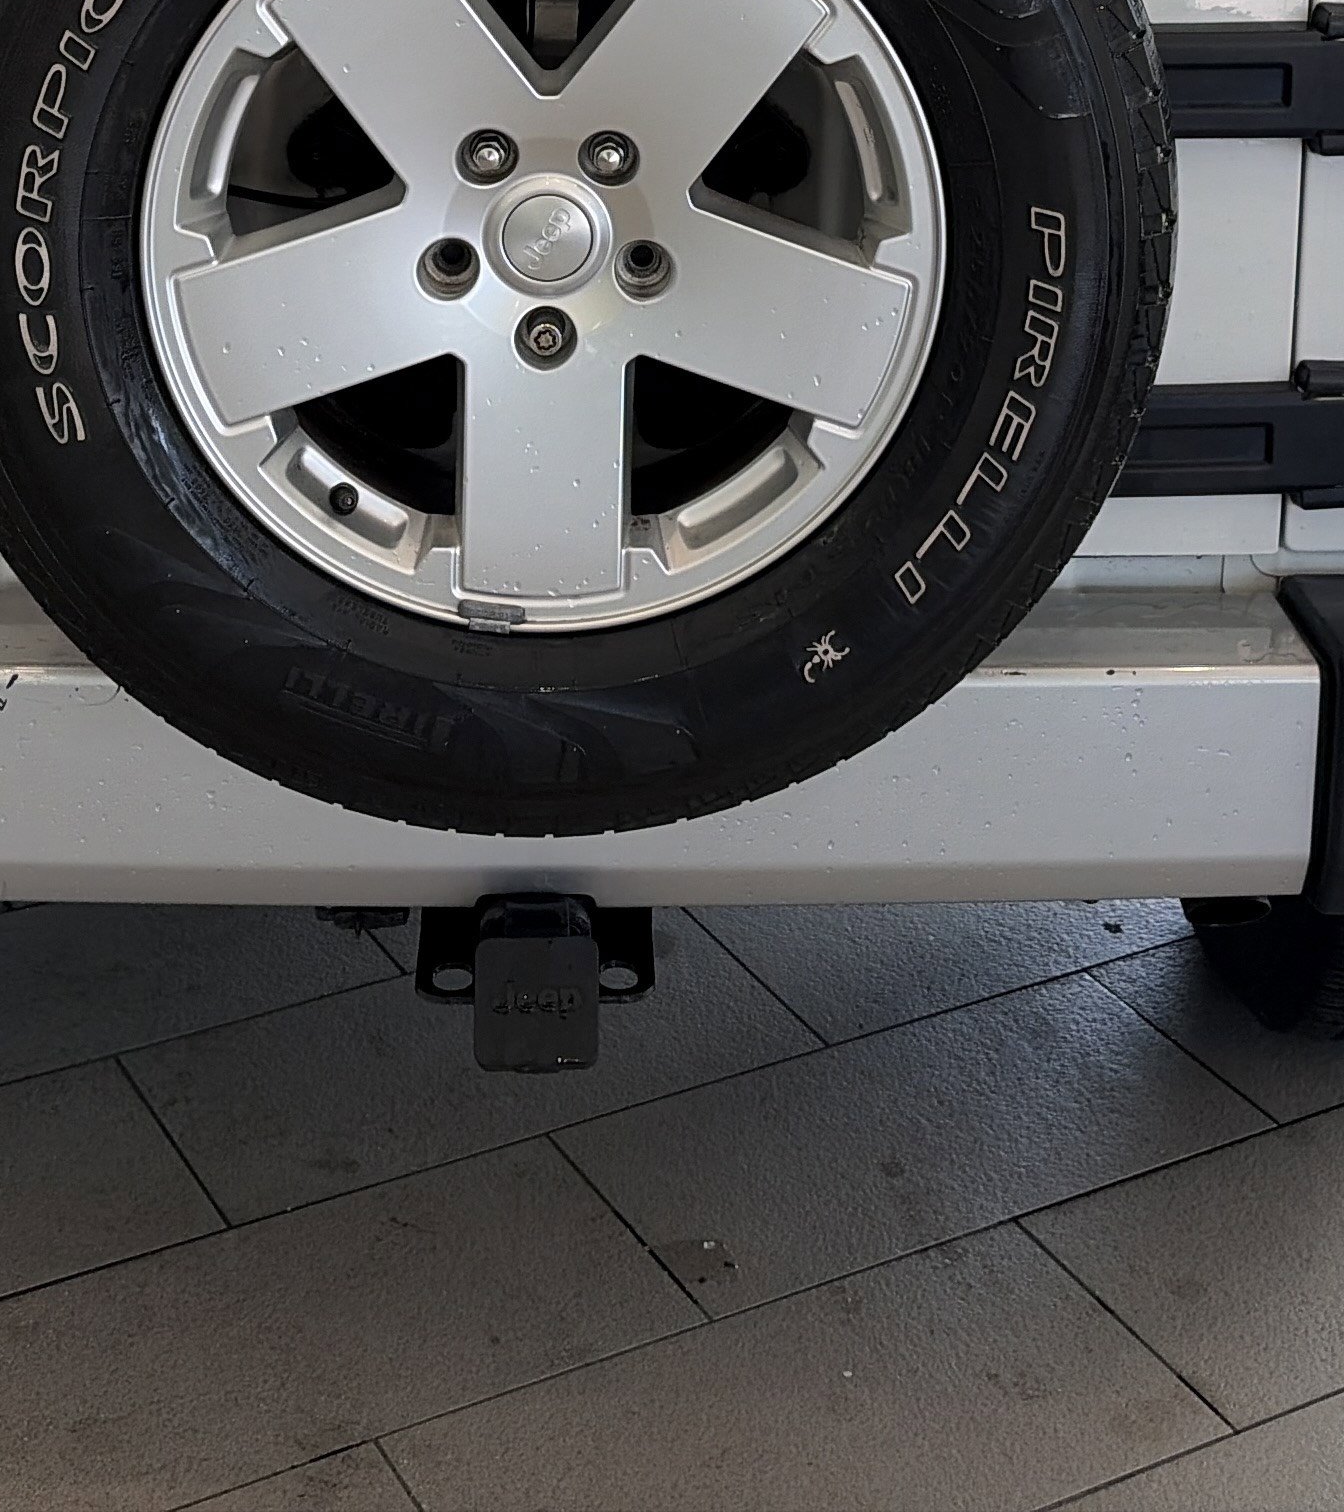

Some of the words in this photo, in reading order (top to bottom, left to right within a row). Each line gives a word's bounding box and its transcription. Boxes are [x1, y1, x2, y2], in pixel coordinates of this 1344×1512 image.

[523, 208, 571, 270] Jeep
[894, 205, 1067, 606] PIRELLI
[493, 981, 584, 1020] Jeep
